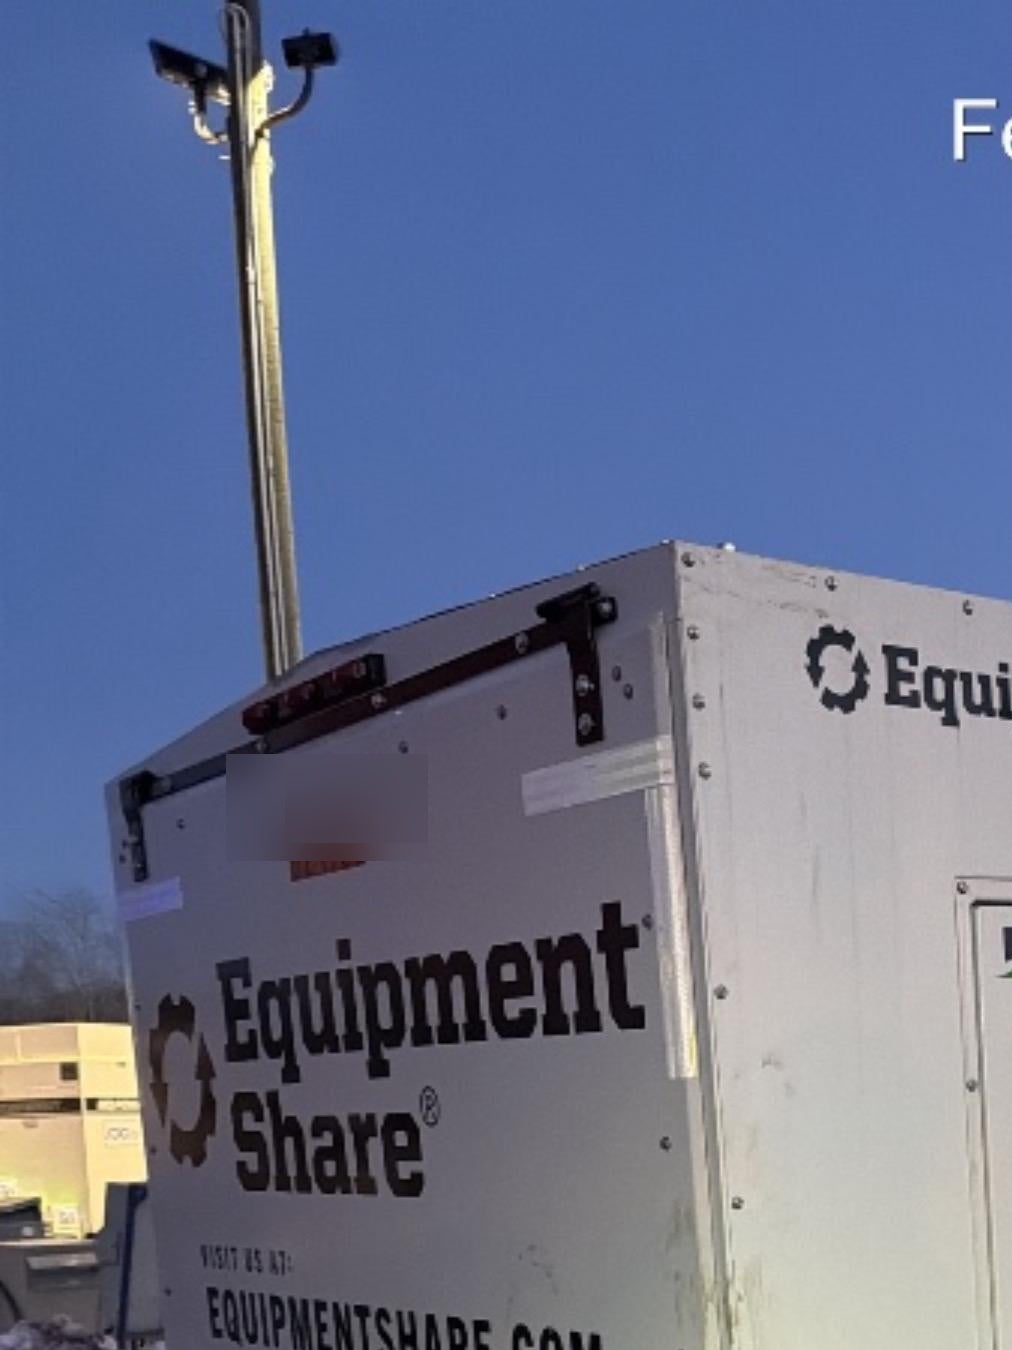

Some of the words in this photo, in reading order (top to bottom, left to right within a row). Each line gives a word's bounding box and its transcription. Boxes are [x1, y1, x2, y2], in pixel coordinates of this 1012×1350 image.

[215, 902, 646, 1084] Equipment
[200, 1244, 238, 1271] VISIT
[245, 1247, 263, 1274] US
